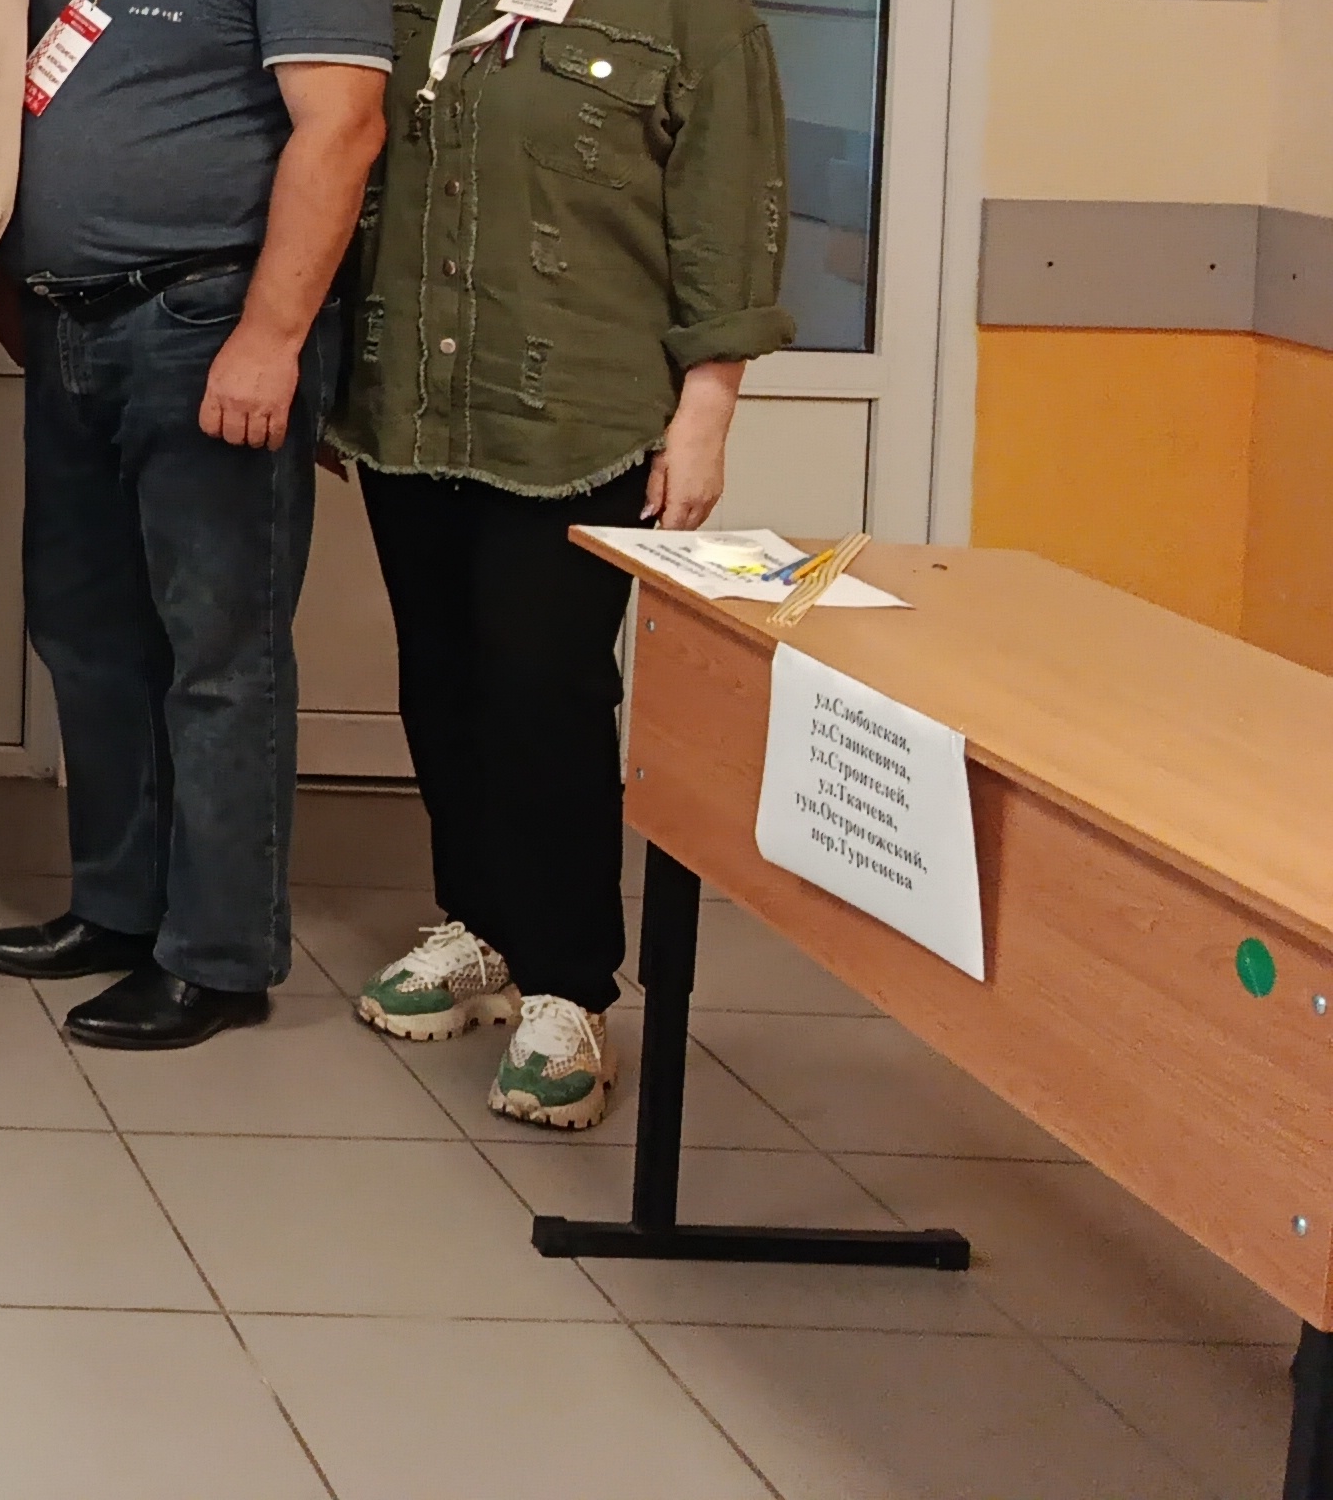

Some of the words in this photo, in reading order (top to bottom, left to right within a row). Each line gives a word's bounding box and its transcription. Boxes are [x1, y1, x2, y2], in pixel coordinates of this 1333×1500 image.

[809, 744, 910, 812] ул.Строителей,
[810, 717, 911, 784] ул.Станкевича,
[817, 777, 898, 833] ул.Ткачева,
[811, 826, 913, 891] пер.Тургенева
